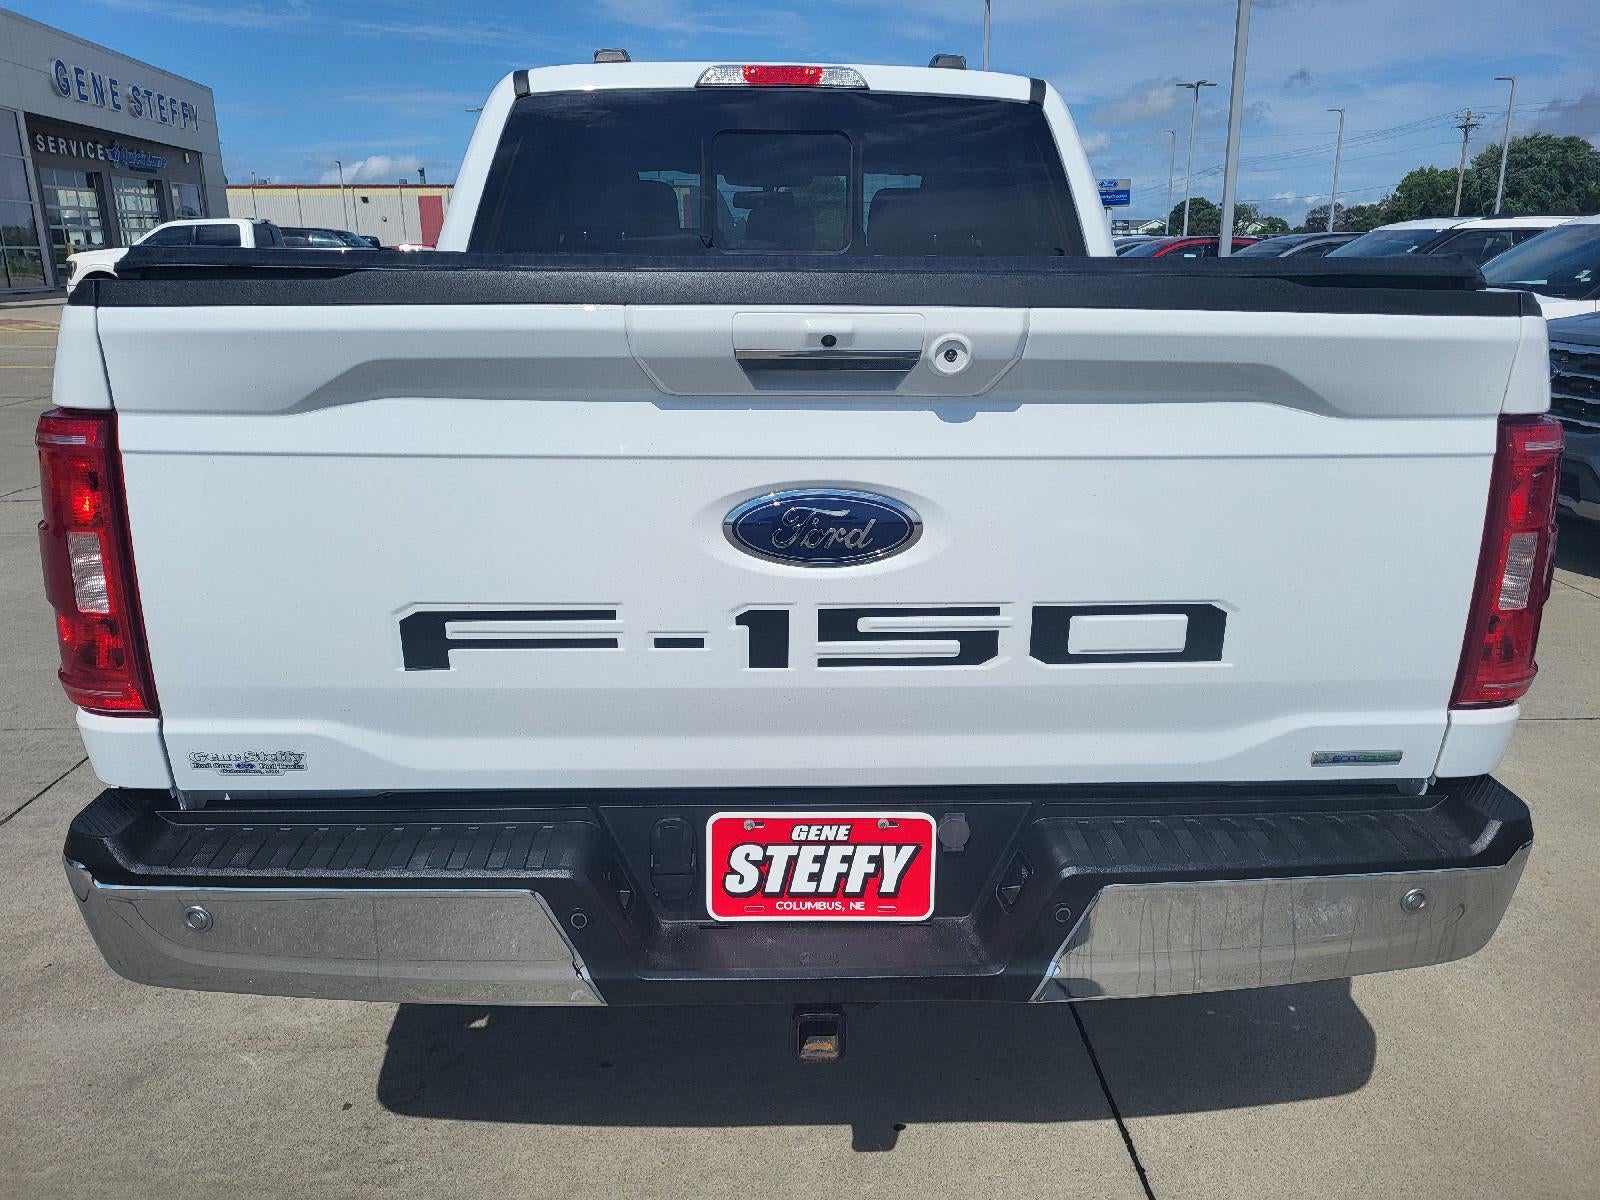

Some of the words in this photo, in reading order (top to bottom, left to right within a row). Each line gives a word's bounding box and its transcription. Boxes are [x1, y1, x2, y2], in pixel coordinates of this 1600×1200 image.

[51, 59, 122, 111] GENE
[129, 85, 199, 133] STEFFY
[36, 134, 105, 160] SERVICE
[771, 506, 876, 550] Ford
[398, 603, 1227, 671] F-150
[189, 751, 242, 762] Gene
[790, 824, 852, 841] GENE
[723, 843, 922, 897] STEFFY
[775, 901, 846, 912] COLUMBUS,
[850, 901, 866, 911] NE
